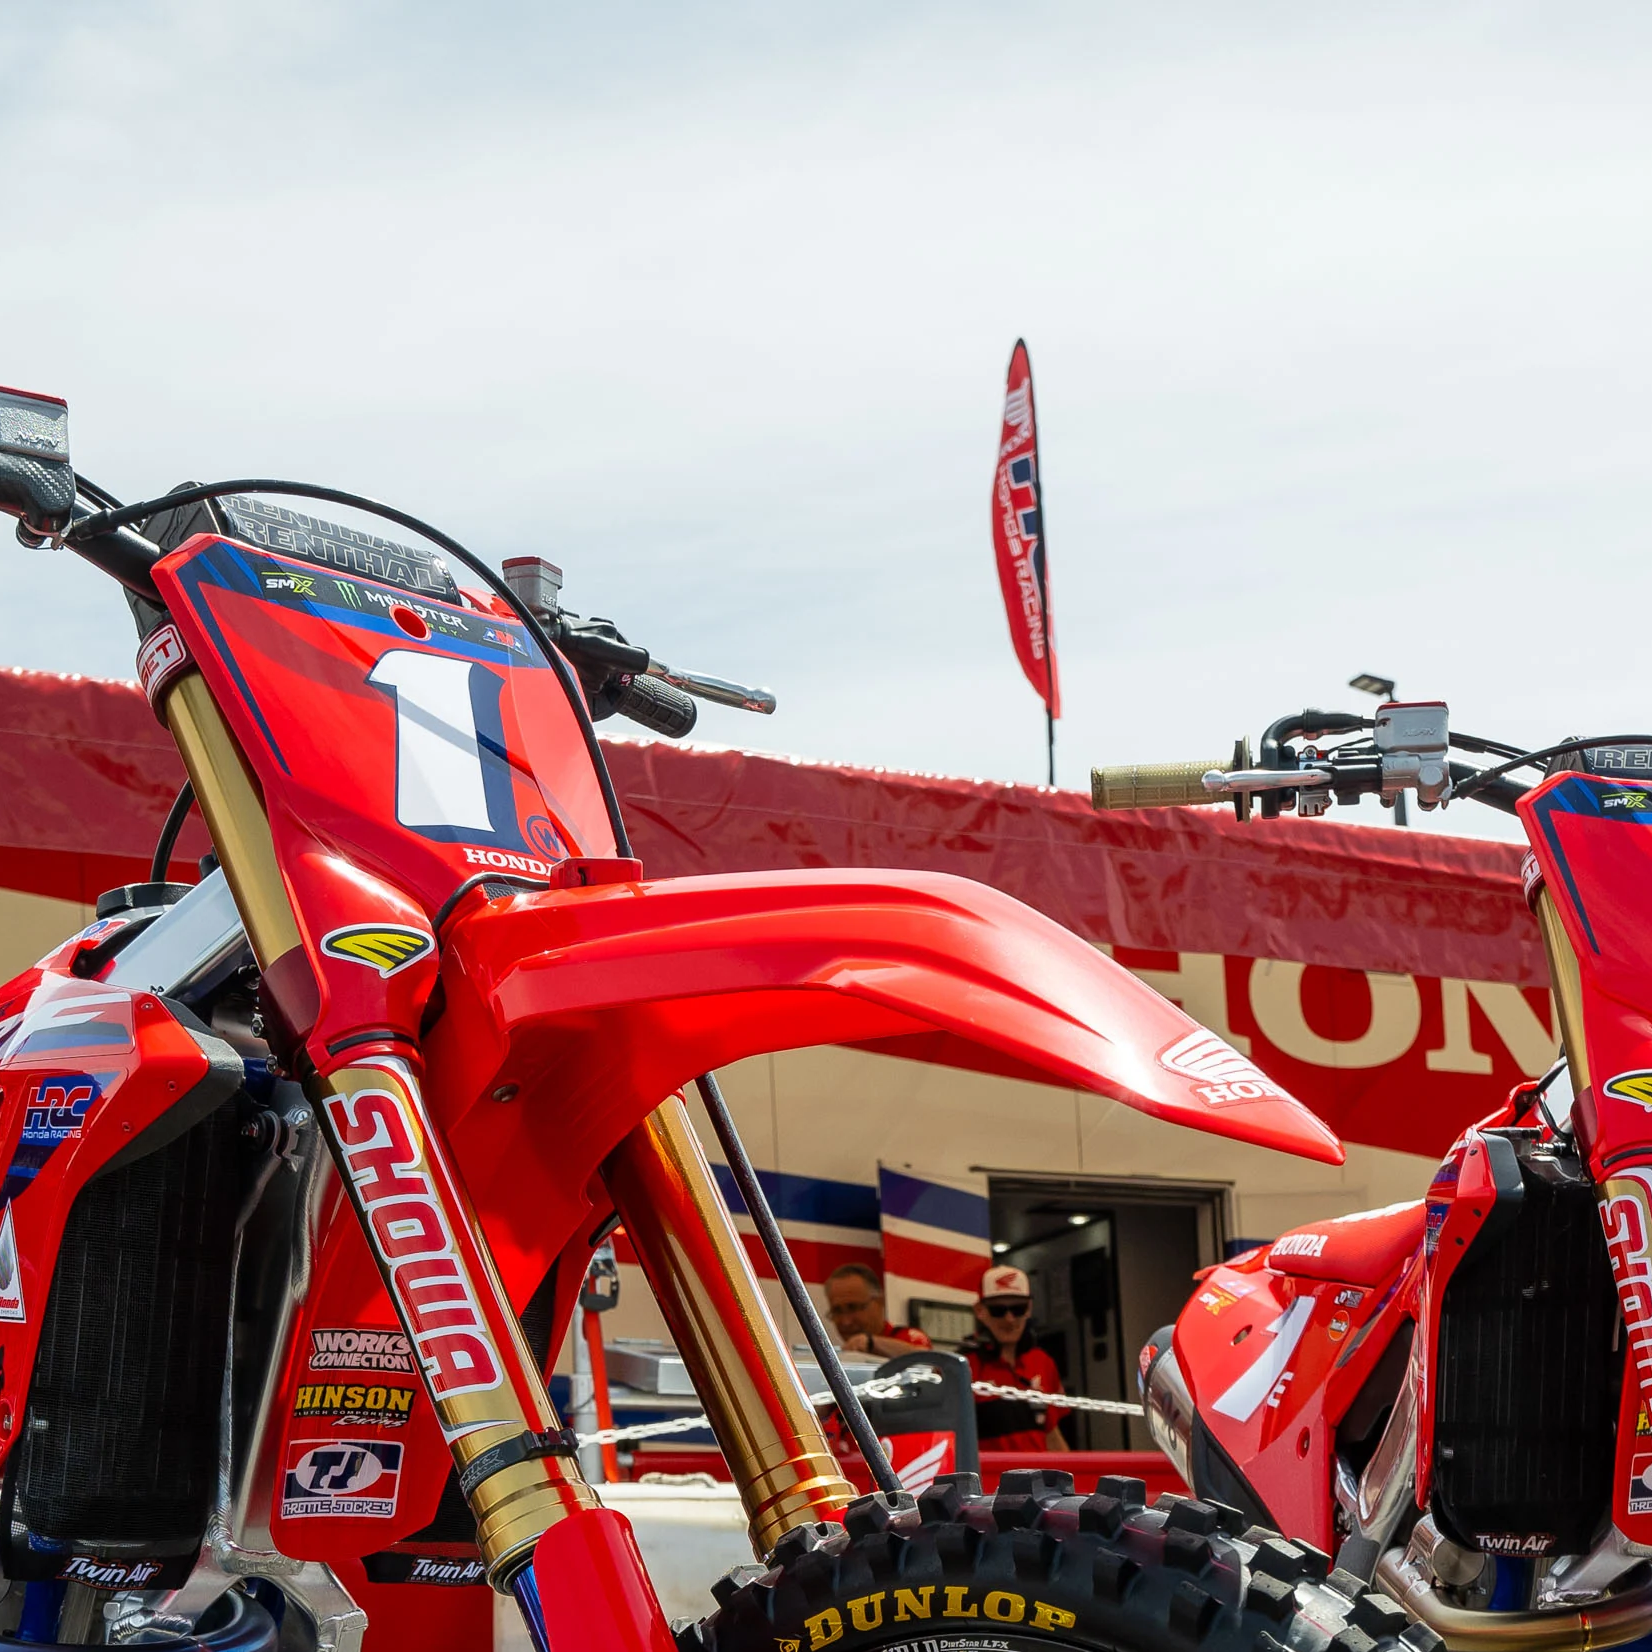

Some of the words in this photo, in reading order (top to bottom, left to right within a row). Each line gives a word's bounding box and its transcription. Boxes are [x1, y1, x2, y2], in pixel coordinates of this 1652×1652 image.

[237, 517, 446, 594] RENTHAL
[265, 573, 317, 597] SMX
[365, 590, 469, 630] MONSTER
[366, 650, 495, 832] 1
[1604, 793, 1647, 808] SMX
[463, 848, 551, 877] HOND
[1197, 1081, 1288, 1106] HON
[23, 1086, 94, 1129] HRC
[22, 1129, 50, 1139] Honda
[50, 1130, 82, 1139] RACING
[322, 1088, 504, 1401] SHOWA
[1271, 1235, 1328, 1257] HONDA
[314, 1332, 411, 1354] WORKS
[311, 1352, 411, 1371] CONNECTION
[1211, 1296, 1316, 1422] 1
[295, 1385, 413, 1411] HINSON
[332, 1410, 408, 1419] COMPONENTS
[308, 1451, 367, 1489] TJ
[283, 1500, 331, 1516] THROTTLE
[332, 1500, 394, 1515] JOCKEY
[1476, 1535, 1524, 1550] Twin
[1523, 1535, 1551, 1551] Air
[411, 1559, 459, 1578] Twin
[459, 1561, 485, 1579] Air
[803, 1585, 1077, 1652] DUNLOP
